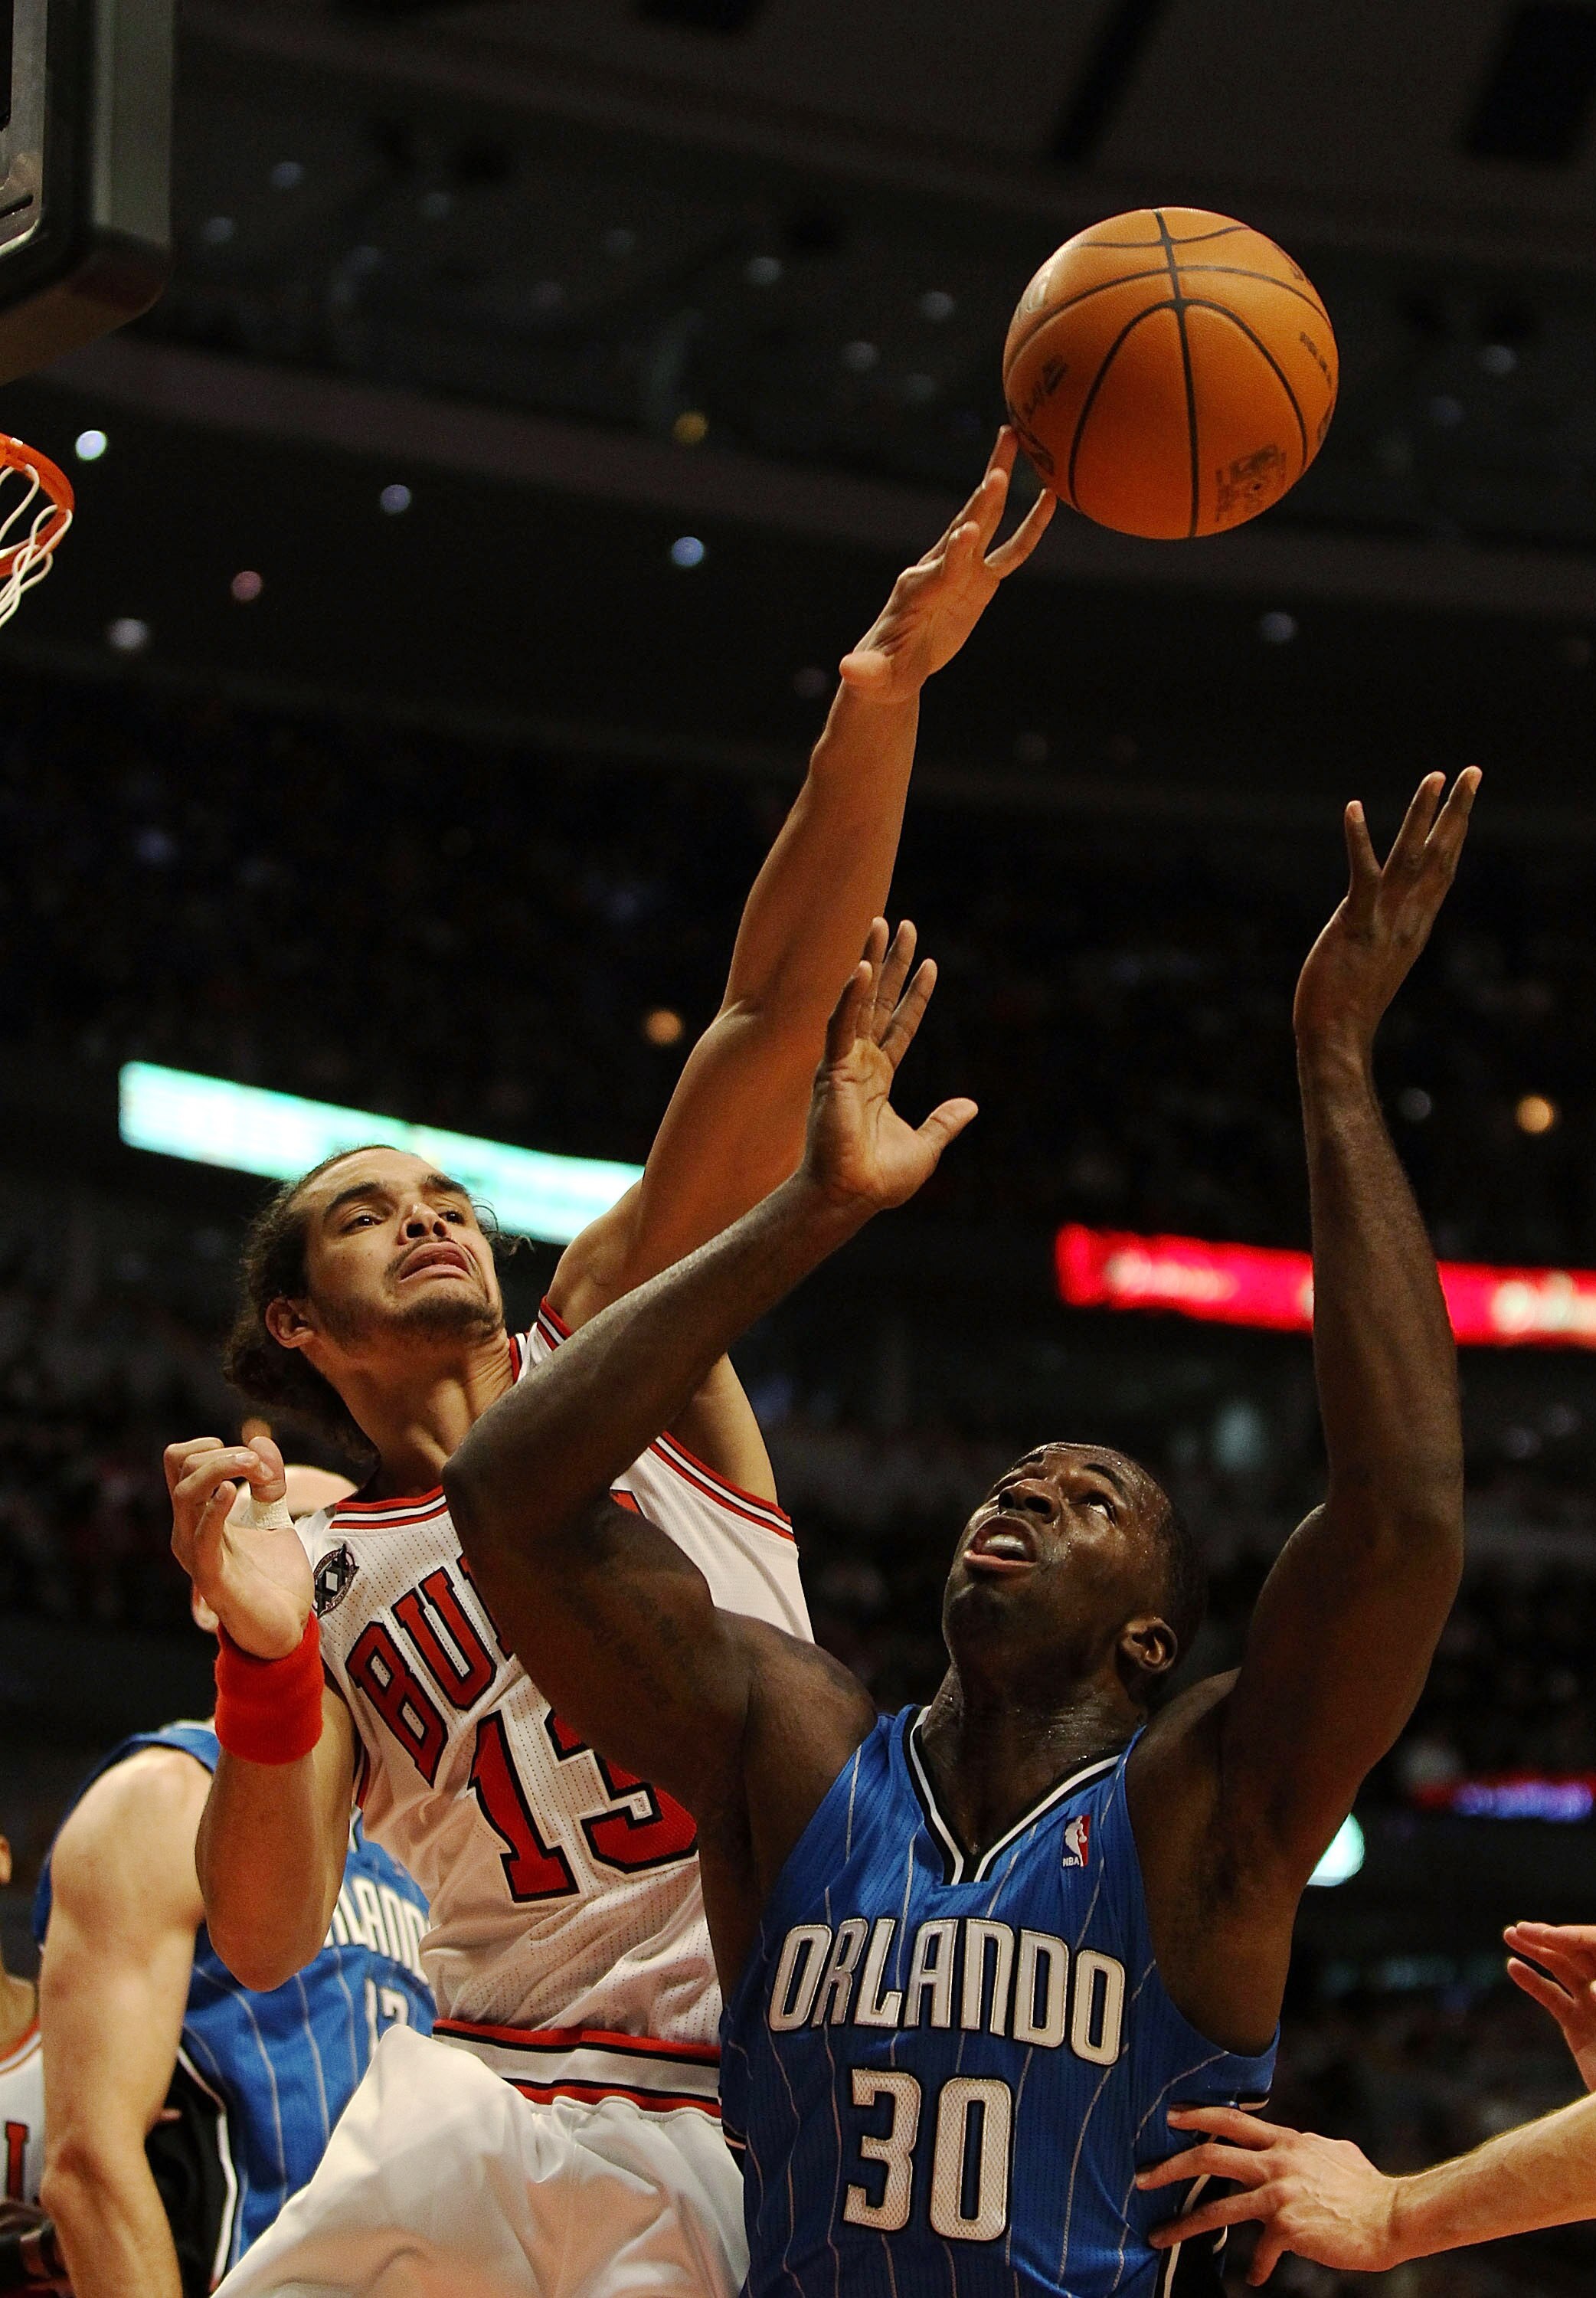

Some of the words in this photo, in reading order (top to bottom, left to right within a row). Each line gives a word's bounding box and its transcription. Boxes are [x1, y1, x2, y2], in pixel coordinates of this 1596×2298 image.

[467, 1709, 698, 1903] 13
[1062, 1856, 1080, 1868] NBA
[767, 1917, 1127, 2067] ORLANDO
[843, 2067, 1012, 2241] 30
